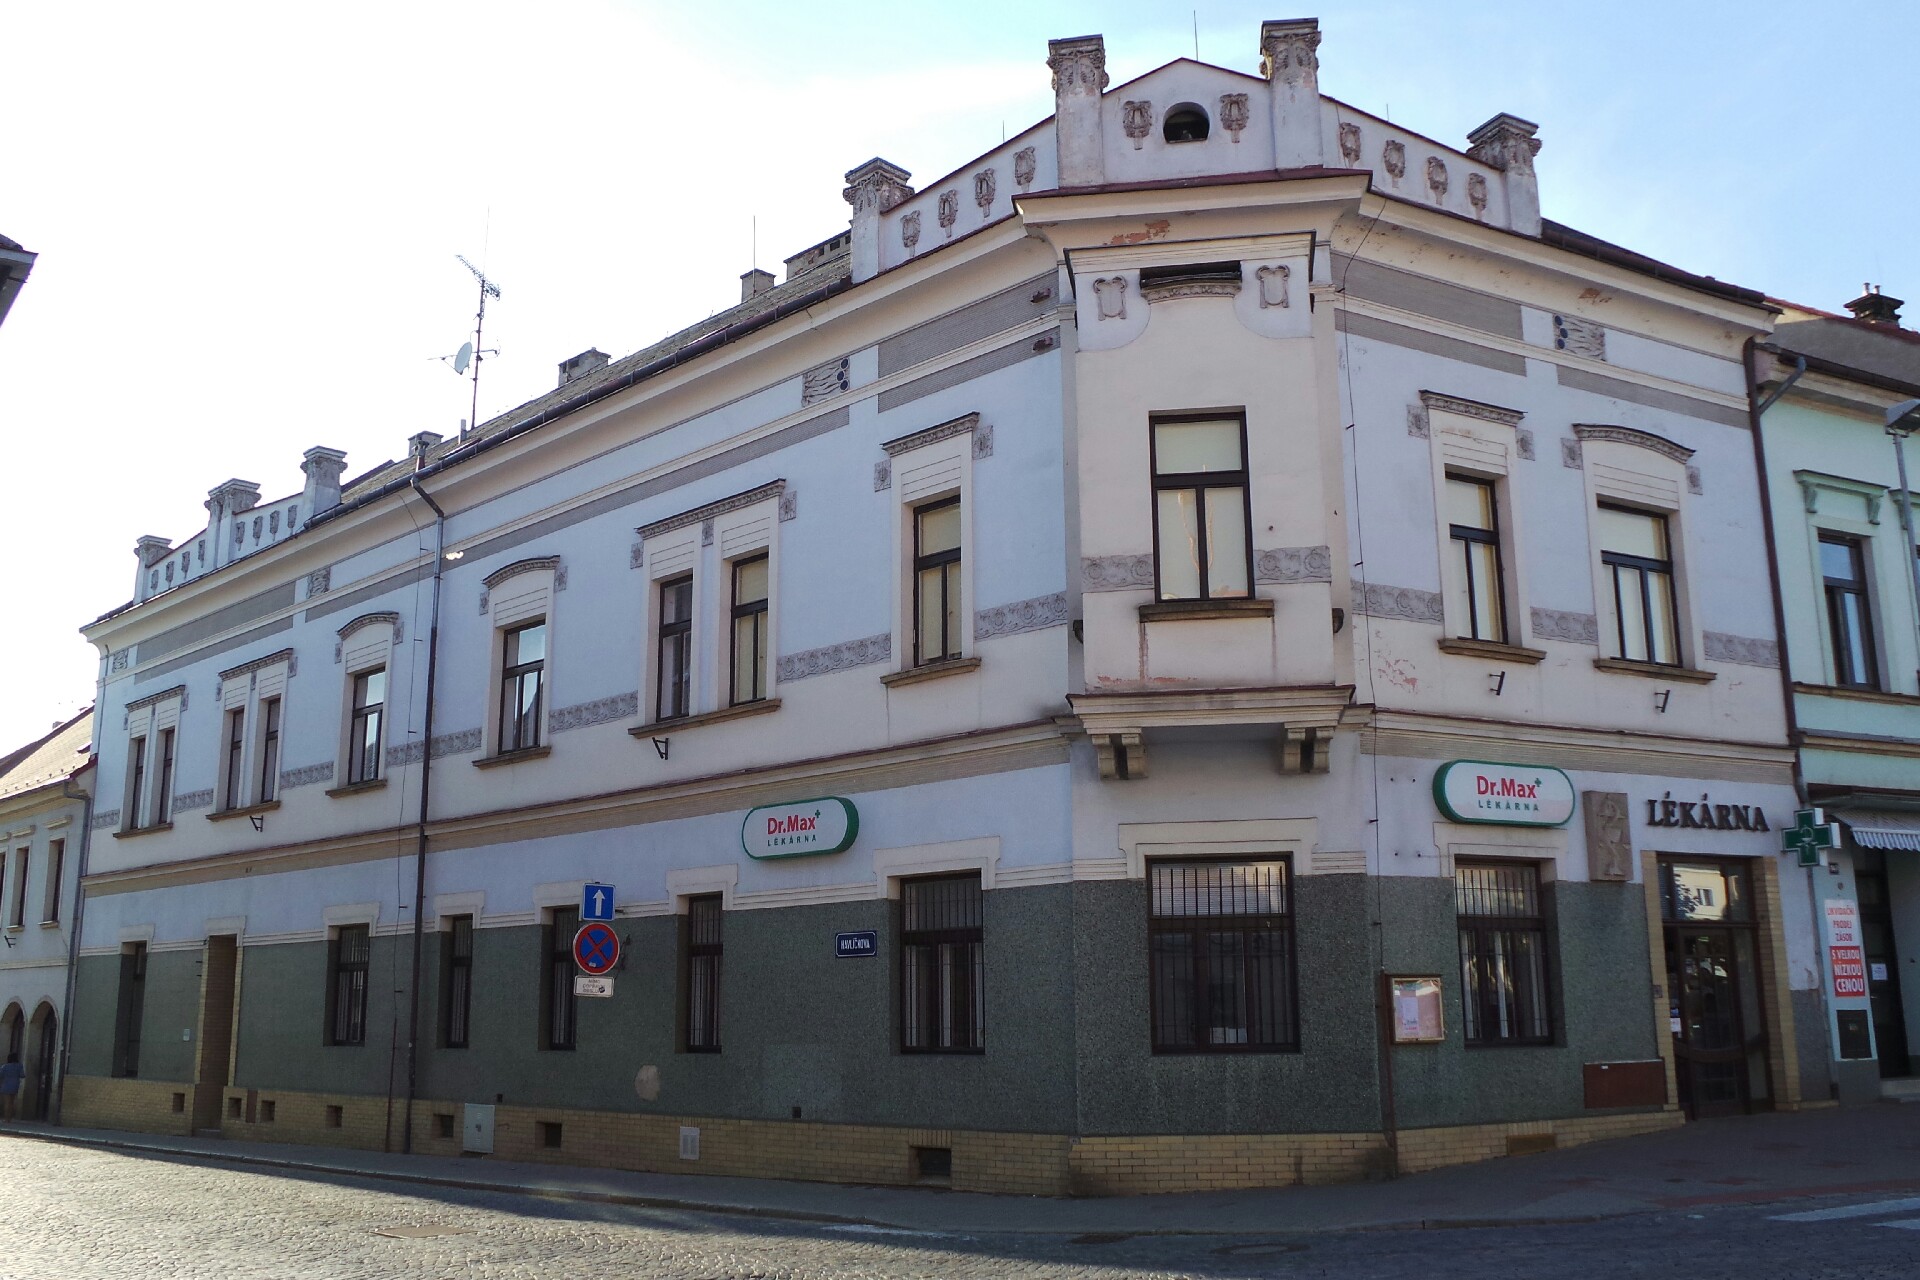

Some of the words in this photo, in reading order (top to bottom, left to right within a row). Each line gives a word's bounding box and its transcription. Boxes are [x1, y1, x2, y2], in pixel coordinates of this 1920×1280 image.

[1476, 775, 1537, 798] Dr.Max
[1478, 799, 1539, 811] LÉKÁRNA
[1645, 790, 1771, 832] LÉKÁRNA
[767, 814, 816, 835] Dr.Max
[767, 834, 817, 847] LÉKÁRNA
[1833, 920, 1852, 929] PRODEJ
[1837, 949, 1860, 960] VELKOU
[1836, 978, 1864, 993] CENOU
